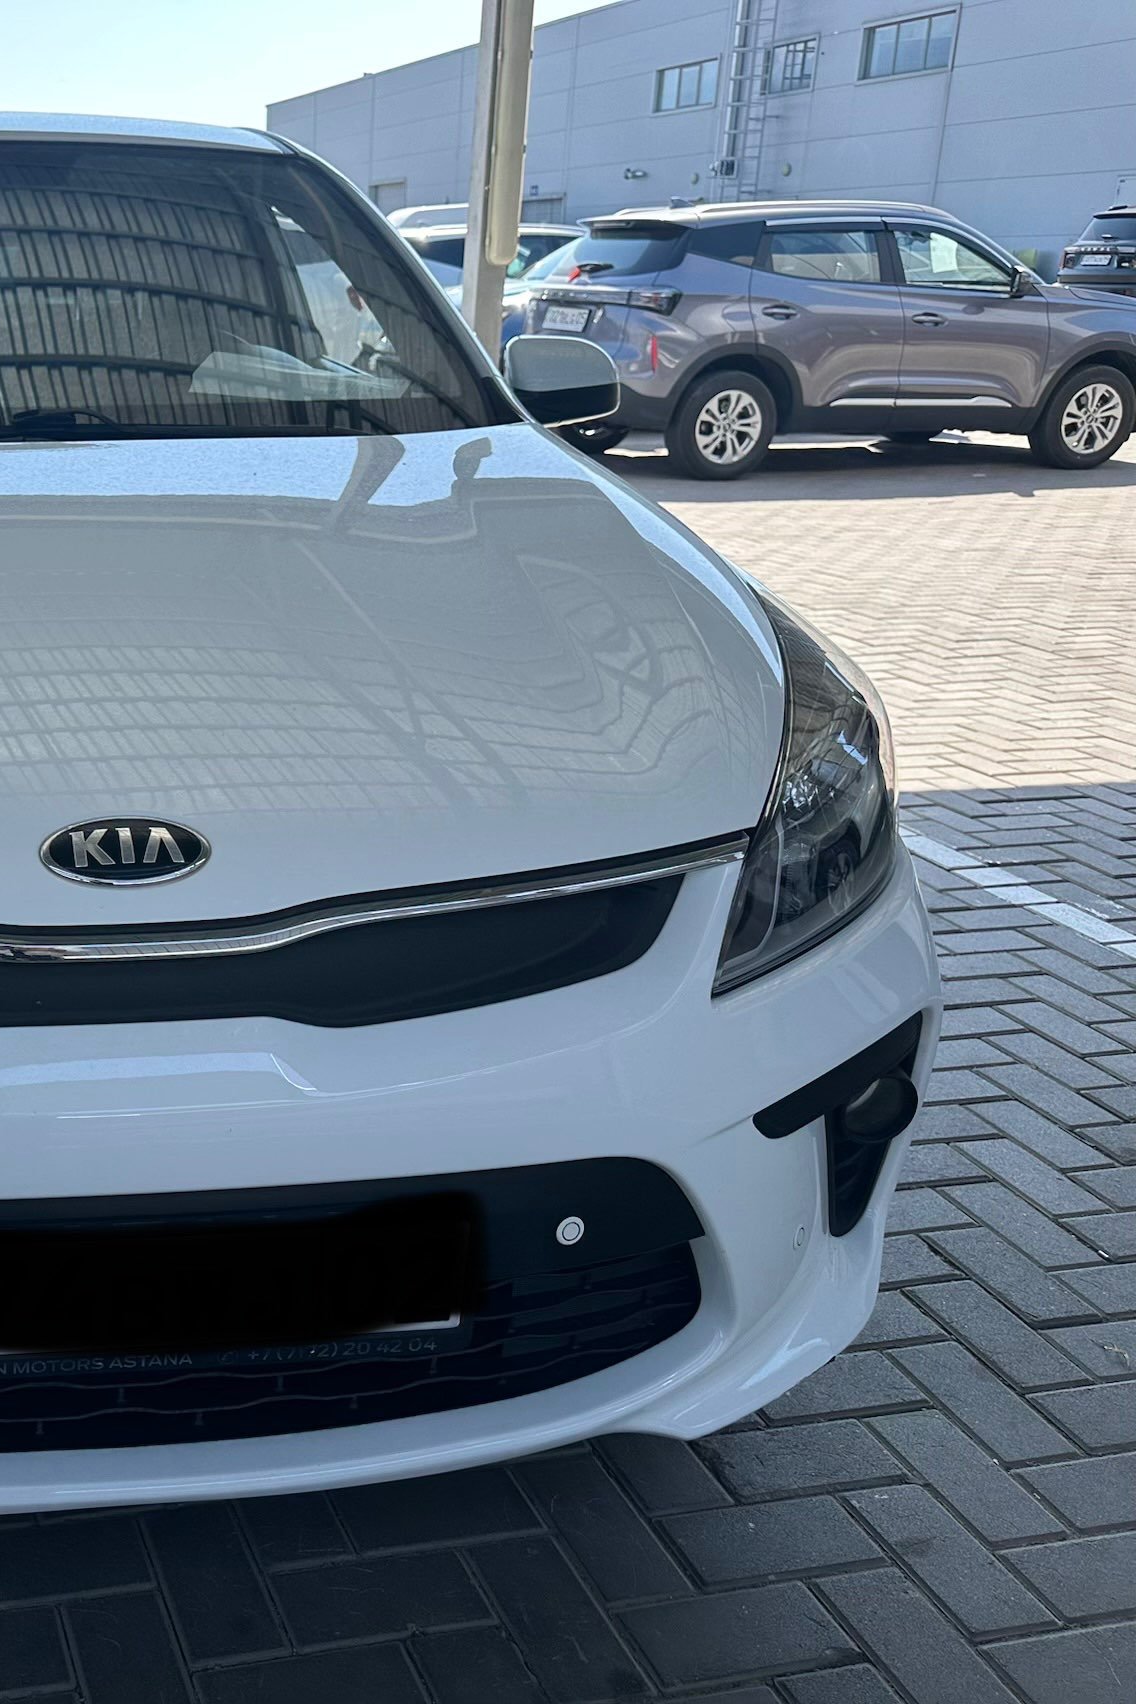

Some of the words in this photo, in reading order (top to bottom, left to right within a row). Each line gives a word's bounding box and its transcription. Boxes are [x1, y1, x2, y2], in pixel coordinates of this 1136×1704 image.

[69, 827, 185, 868] KIA
[408, 1337, 438, 1351] 04
[14, 1357, 104, 1375] MOTORS
[109, 1353, 193, 1369] ASTANA
